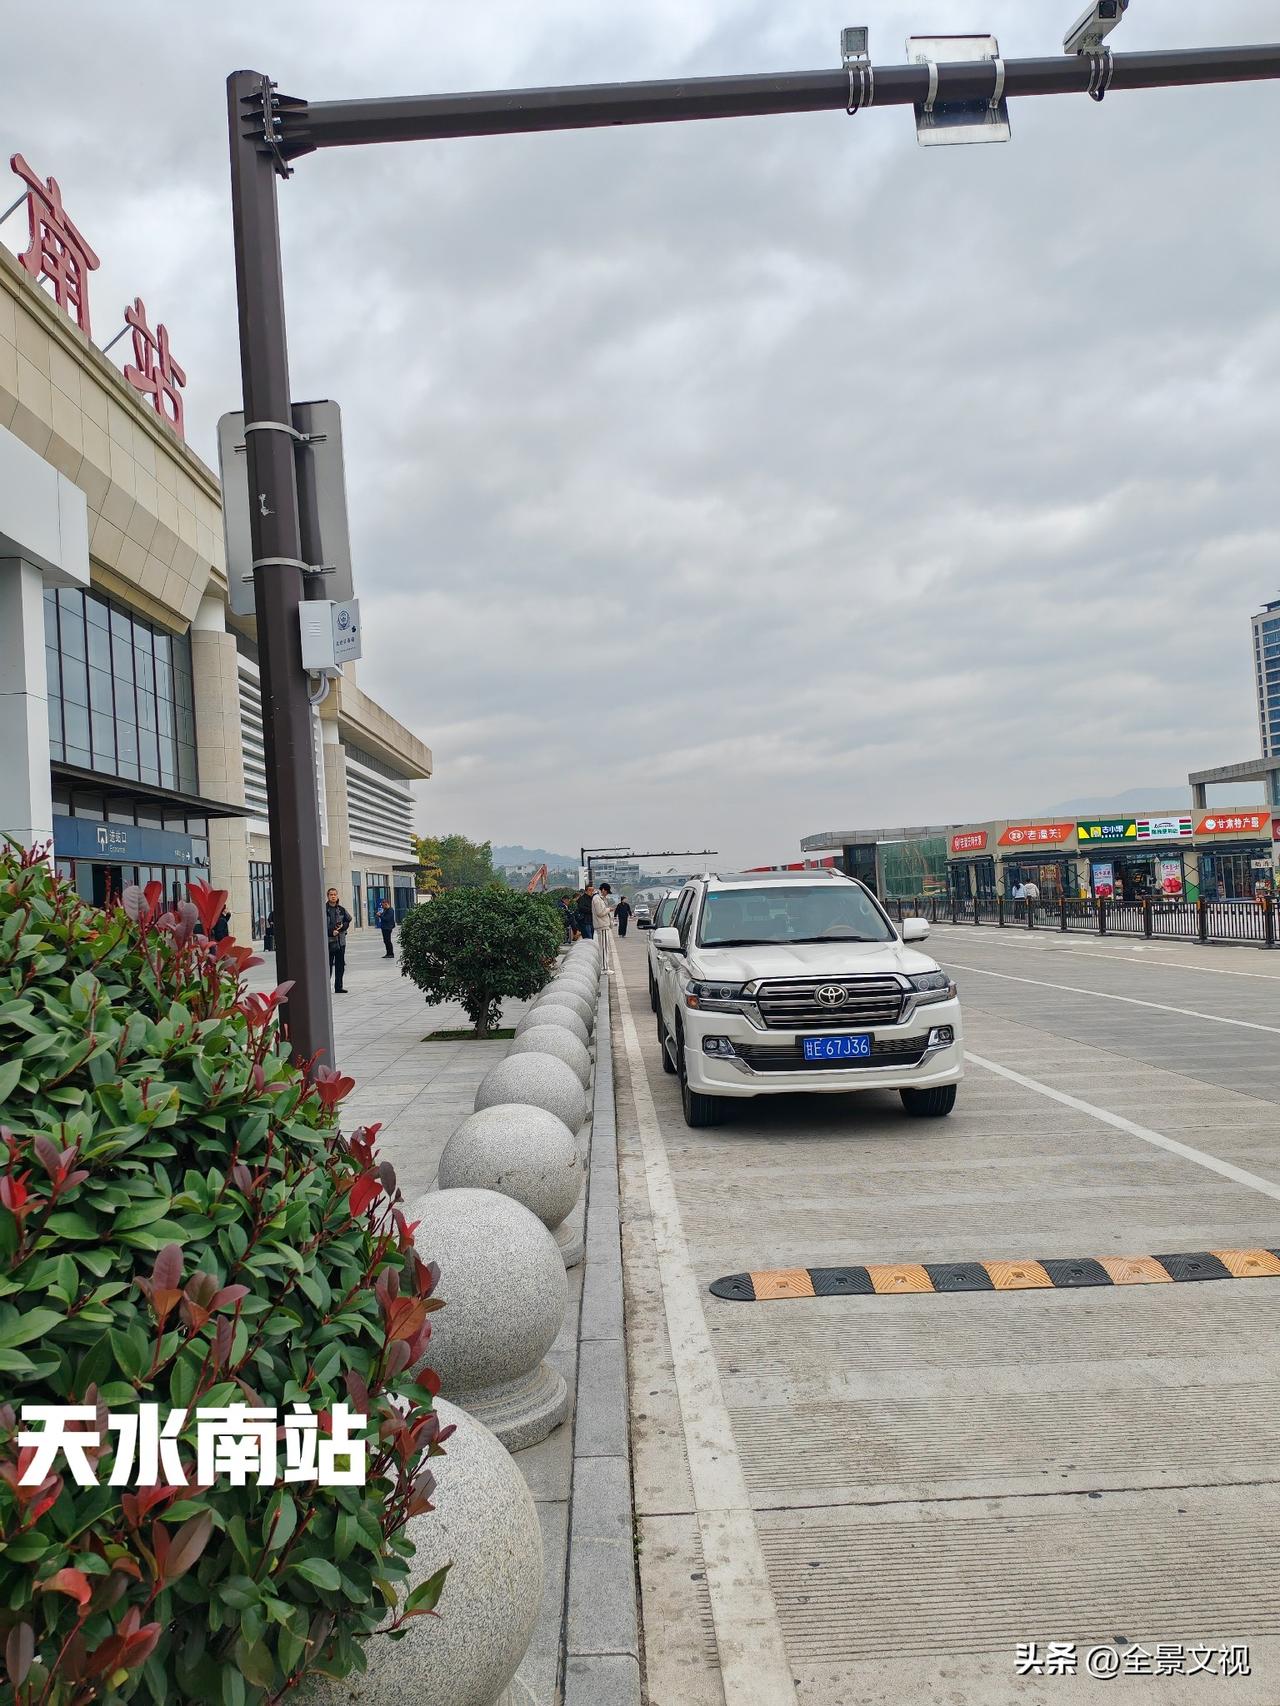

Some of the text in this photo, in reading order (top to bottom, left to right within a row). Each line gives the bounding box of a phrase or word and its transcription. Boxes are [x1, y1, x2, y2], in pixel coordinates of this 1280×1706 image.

[10, 153, 186, 441] 南站
[109, 829, 127, 844] 进站口
